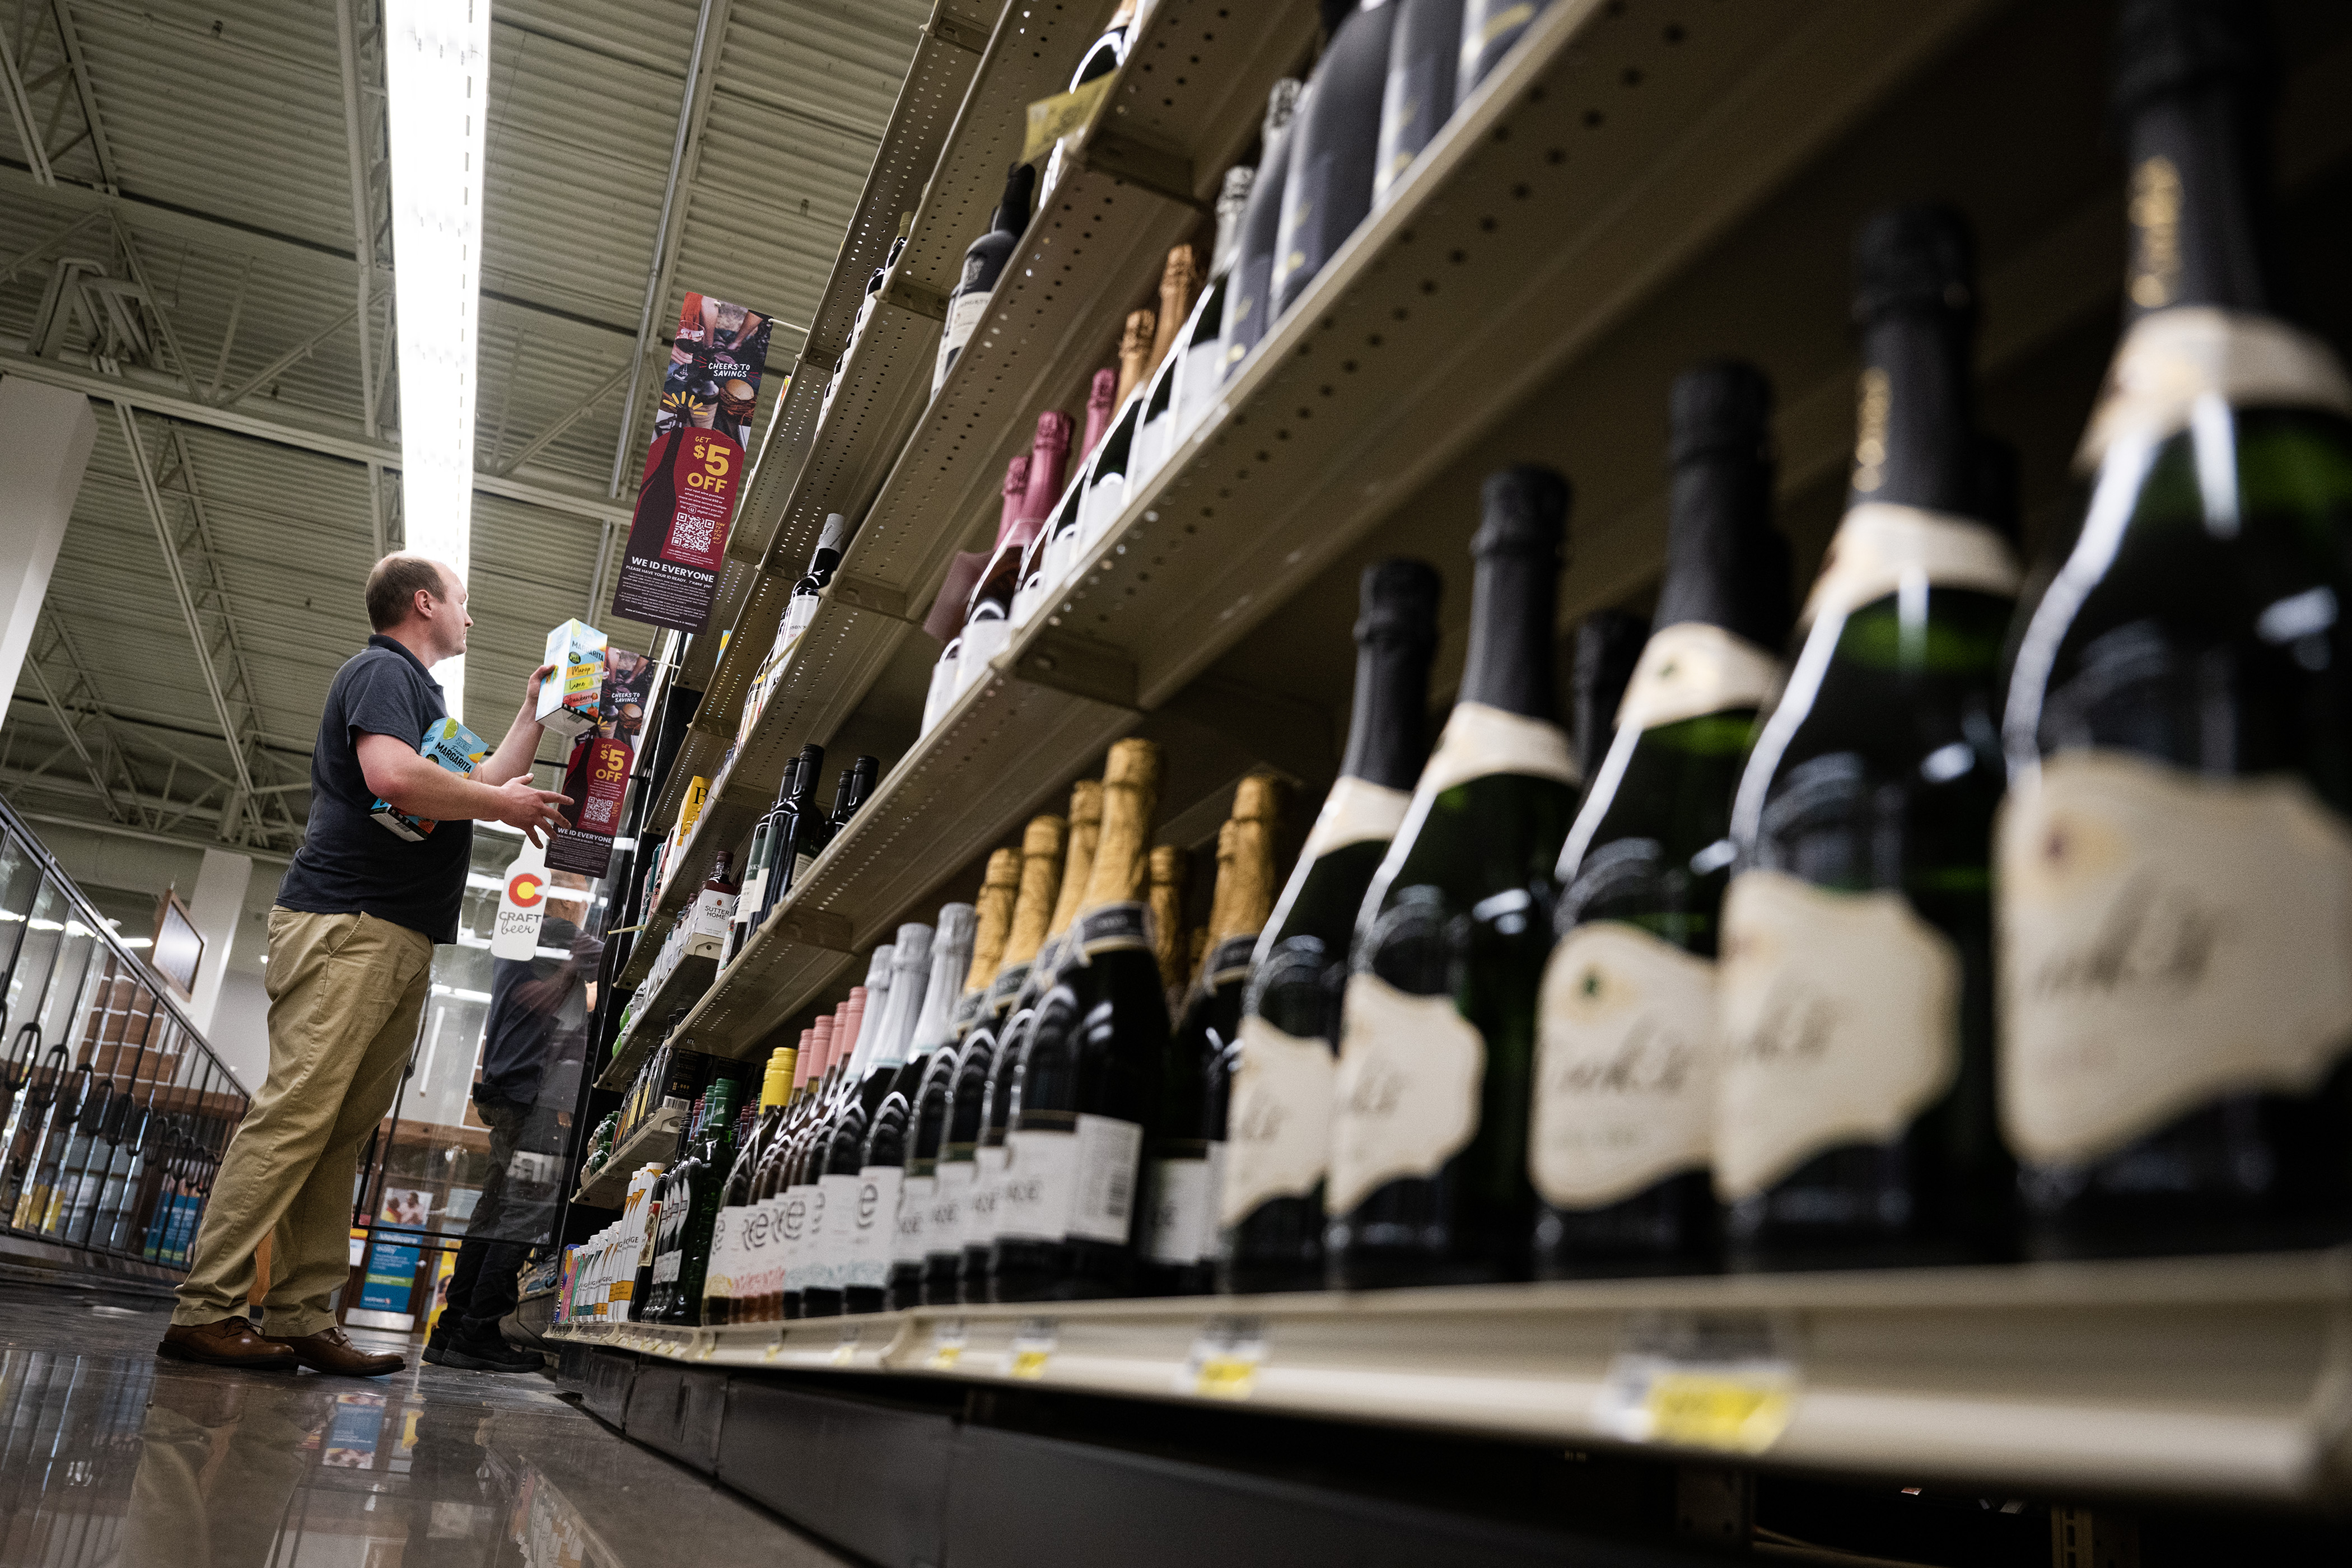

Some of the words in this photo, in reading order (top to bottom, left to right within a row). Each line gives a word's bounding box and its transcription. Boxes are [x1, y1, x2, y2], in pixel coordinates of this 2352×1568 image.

[693, 444, 730, 476] $5
[687, 473, 727, 493] OFF
[631, 556, 648, 567] WE
[649, 561, 661, 570] ID
[661, 563, 714, 583] EVERYONE
[572, 640, 604, 662] MARGARITA
[569, 680, 586, 690] Lime
[435, 741, 472, 773] MARGARITA
[600, 748, 625, 771] $5
[596, 768, 623, 782] OFF
[577, 832, 612, 843] EVERYONE
[500, 911, 542, 923] CRAFT
[704, 905, 730, 916] SUTTER
[706, 912, 726, 921] HOME
[501, 919, 535, 935] beer
